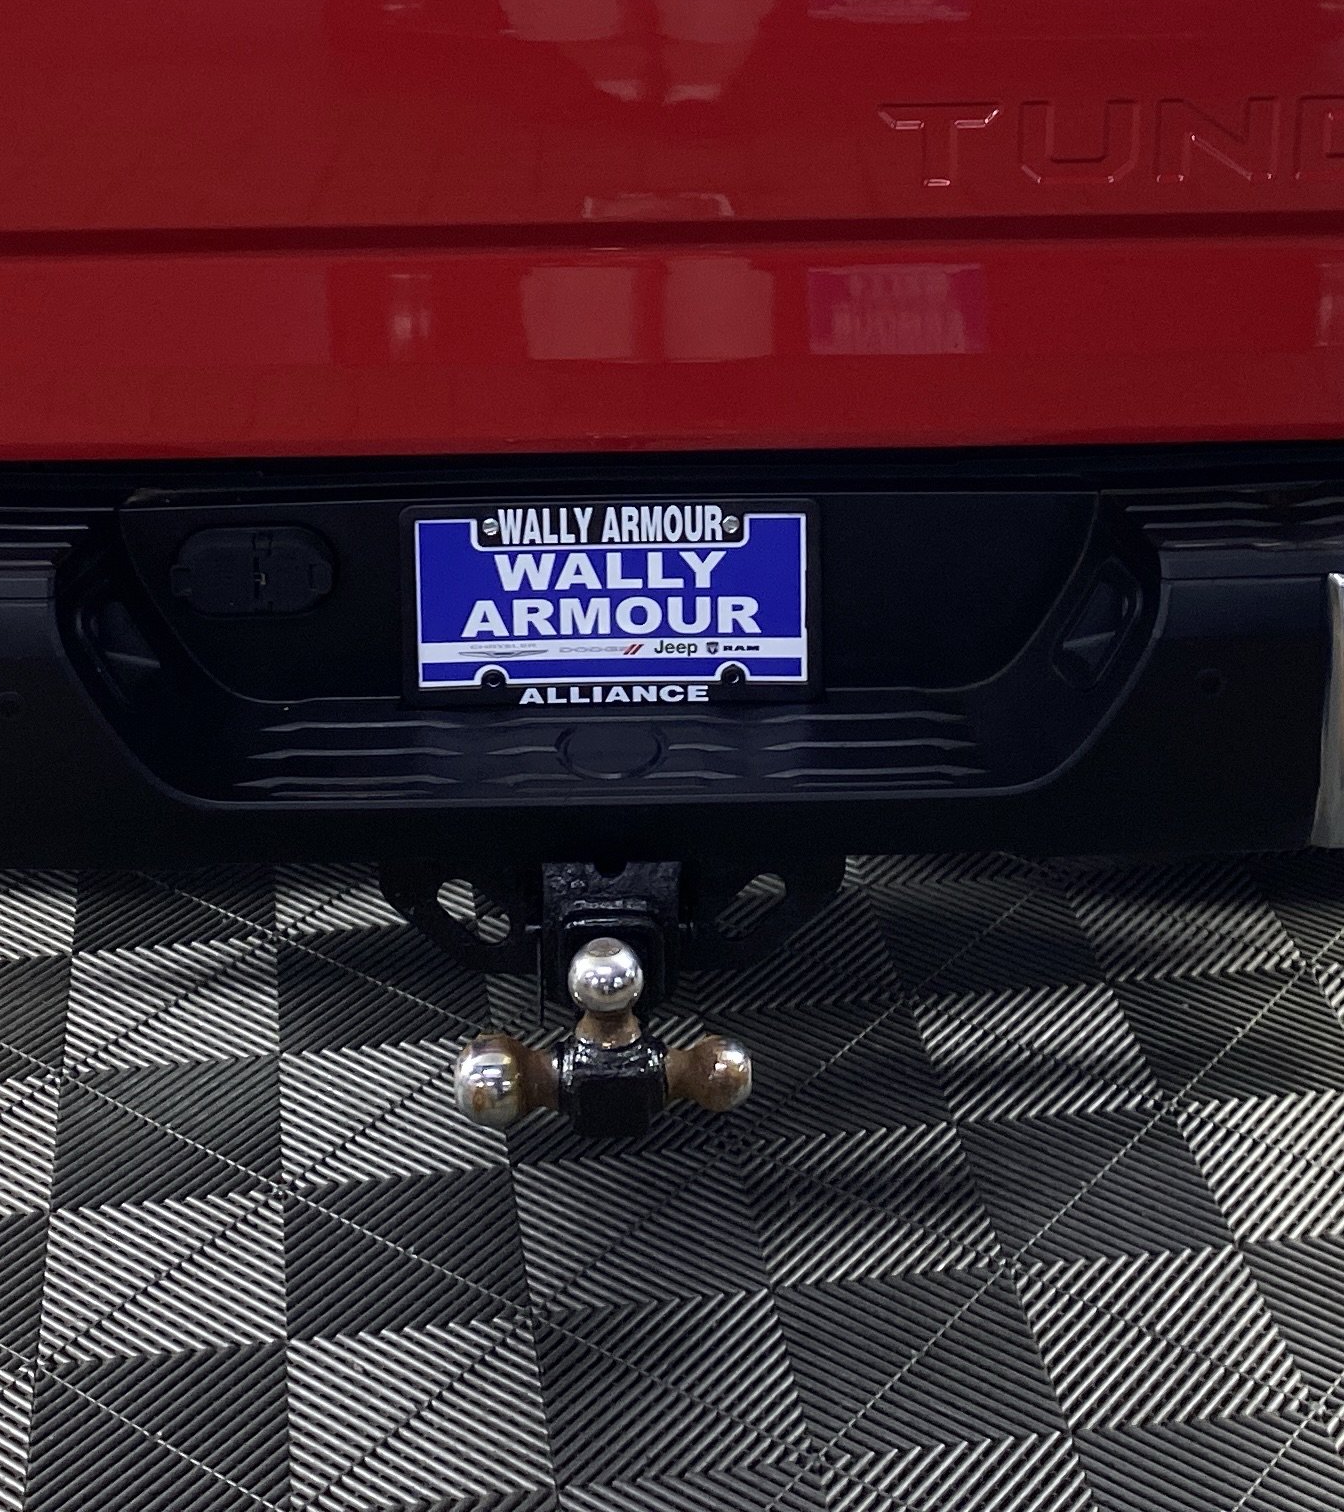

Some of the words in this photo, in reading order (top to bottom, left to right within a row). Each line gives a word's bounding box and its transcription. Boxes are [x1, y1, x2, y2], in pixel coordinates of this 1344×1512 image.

[498, 507, 593, 544] WALLY
[602, 505, 723, 542] ARMOUR
[494, 551, 726, 591] WALLY
[461, 596, 762, 638] ARMOUR
[654, 640, 698, 656] Jeep
[519, 685, 709, 704] ALLIANCE
